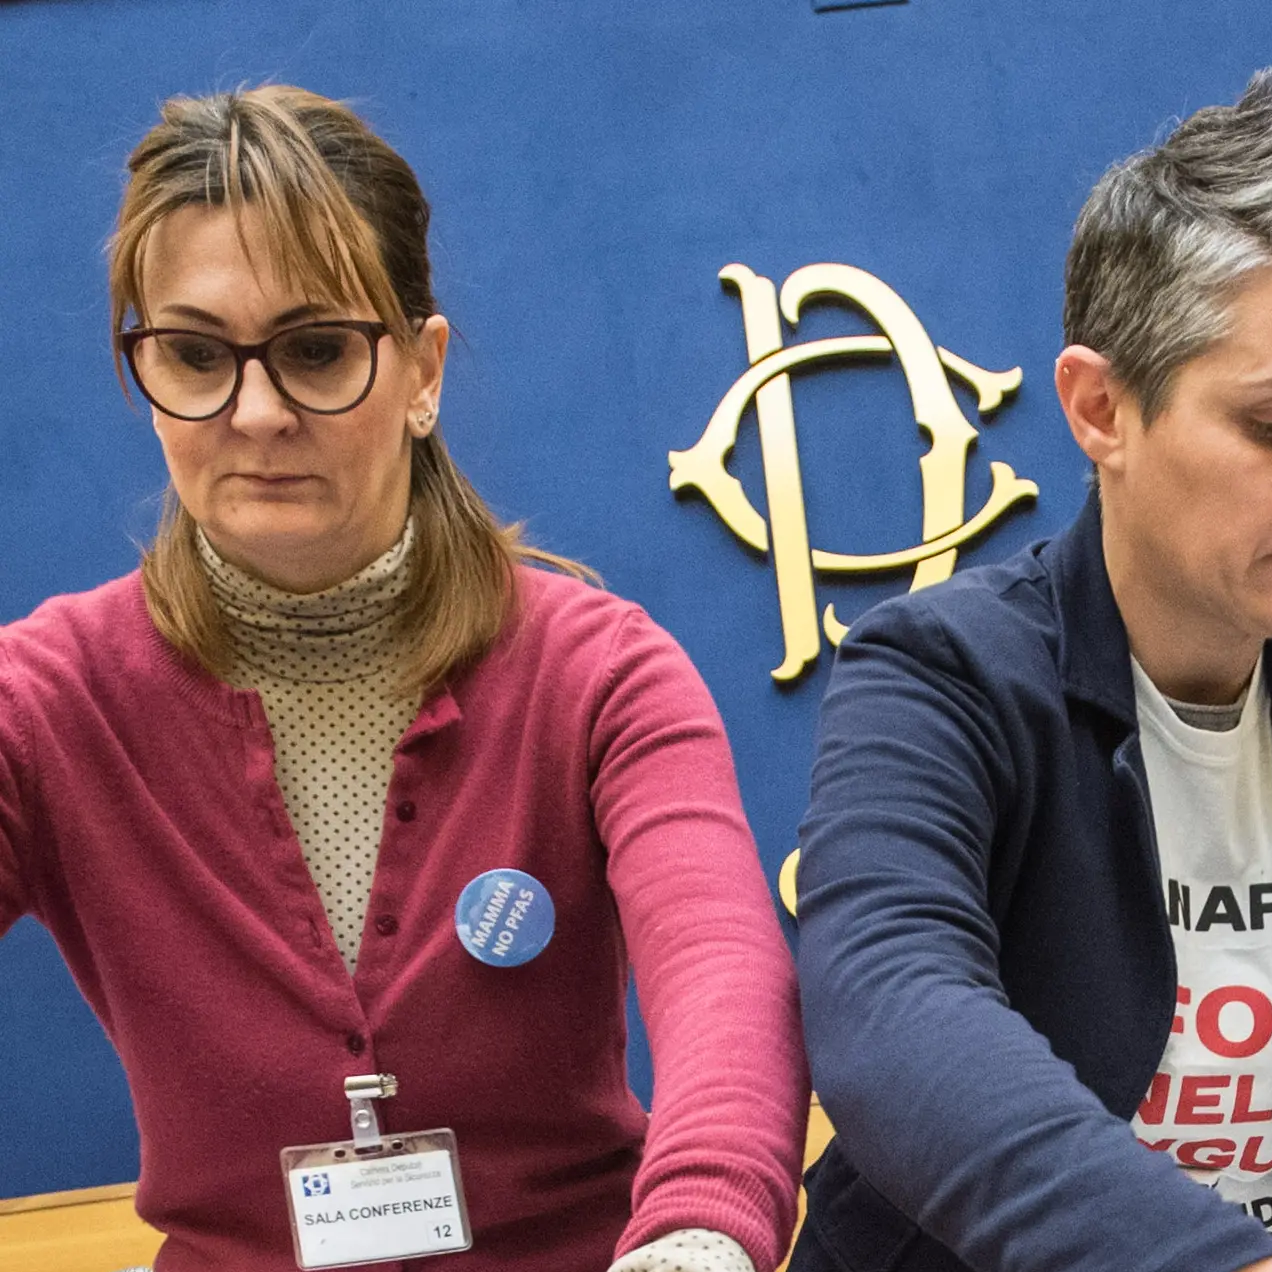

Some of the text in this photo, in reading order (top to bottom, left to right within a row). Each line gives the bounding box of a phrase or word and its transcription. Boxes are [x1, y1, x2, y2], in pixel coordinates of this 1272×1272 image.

[470, 881, 515, 949] MAMMA
[491, 888, 535, 957] NO PFAS
[305, 1195, 453, 1226] SALA CONFERENZE
[433, 1224, 453, 1240] 12
